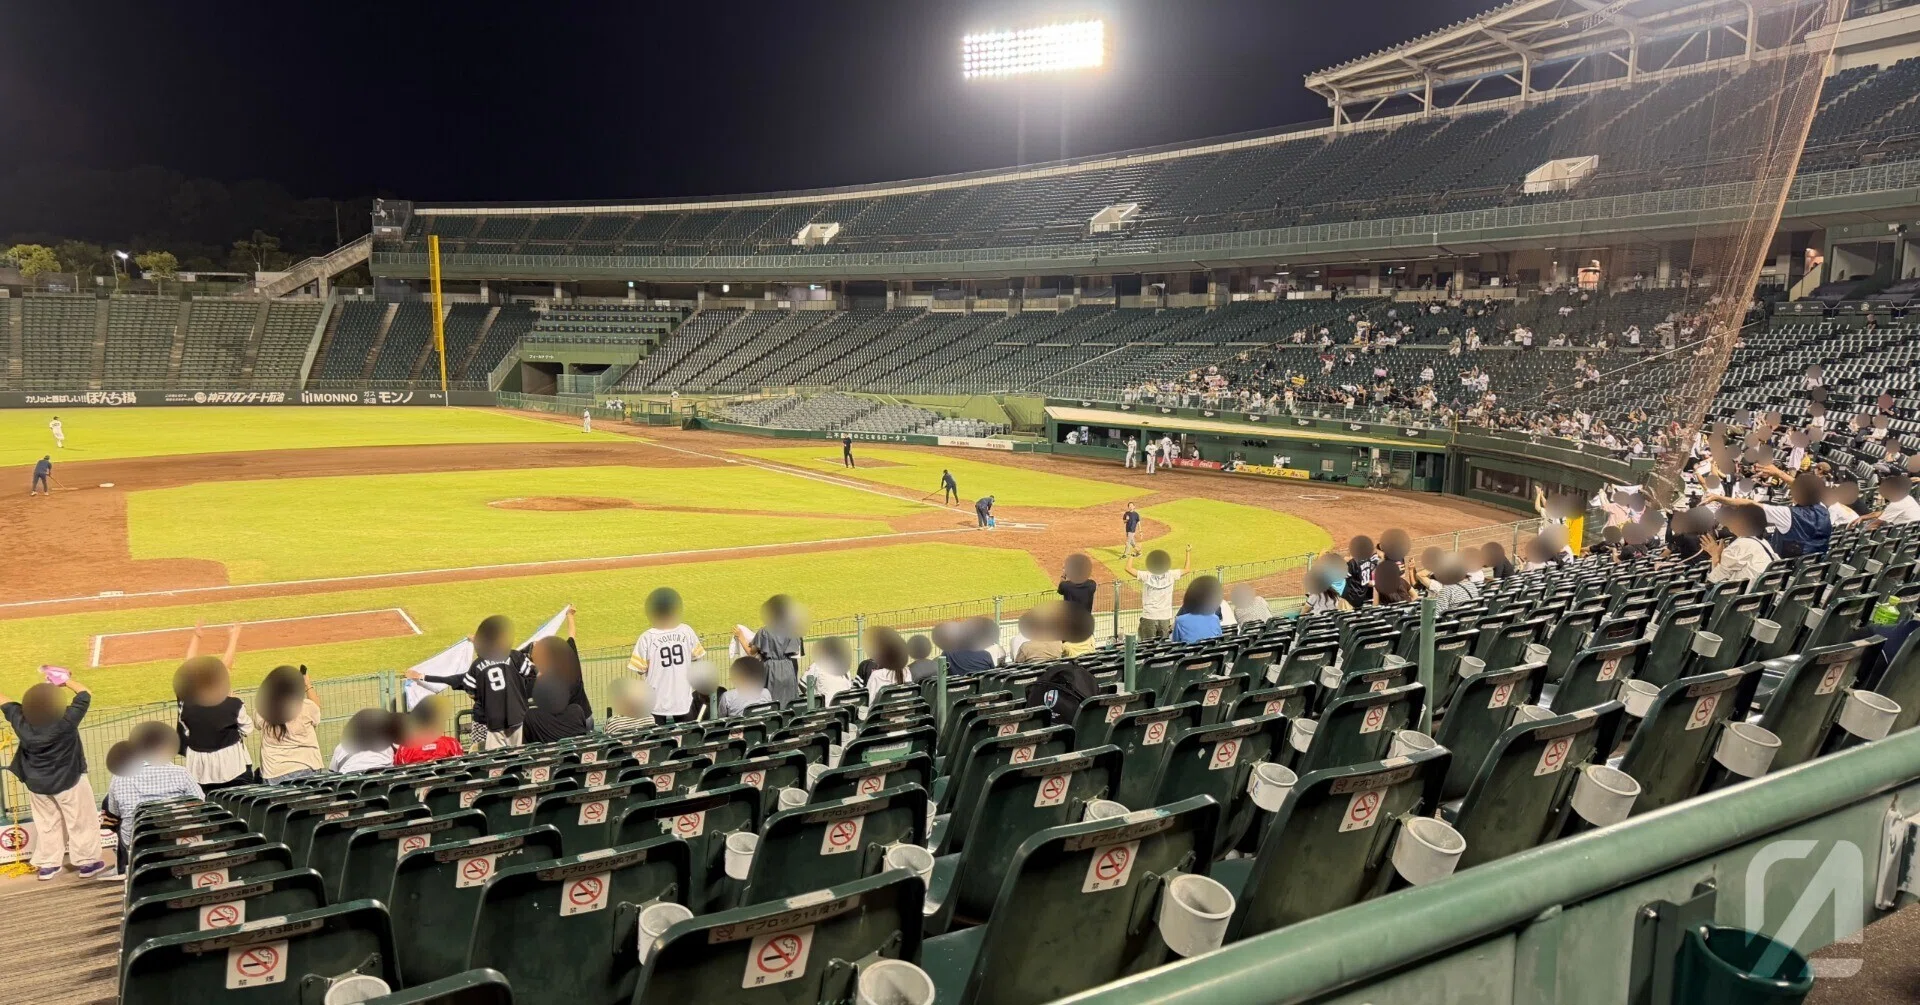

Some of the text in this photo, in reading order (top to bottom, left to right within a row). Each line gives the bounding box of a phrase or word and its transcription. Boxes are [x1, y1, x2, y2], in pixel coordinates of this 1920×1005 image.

[314, 393, 358, 403] MONNO
[378, 391, 414, 403] モンノ
[660, 644, 684, 668] 99
[487, 667, 506, 691] 9
